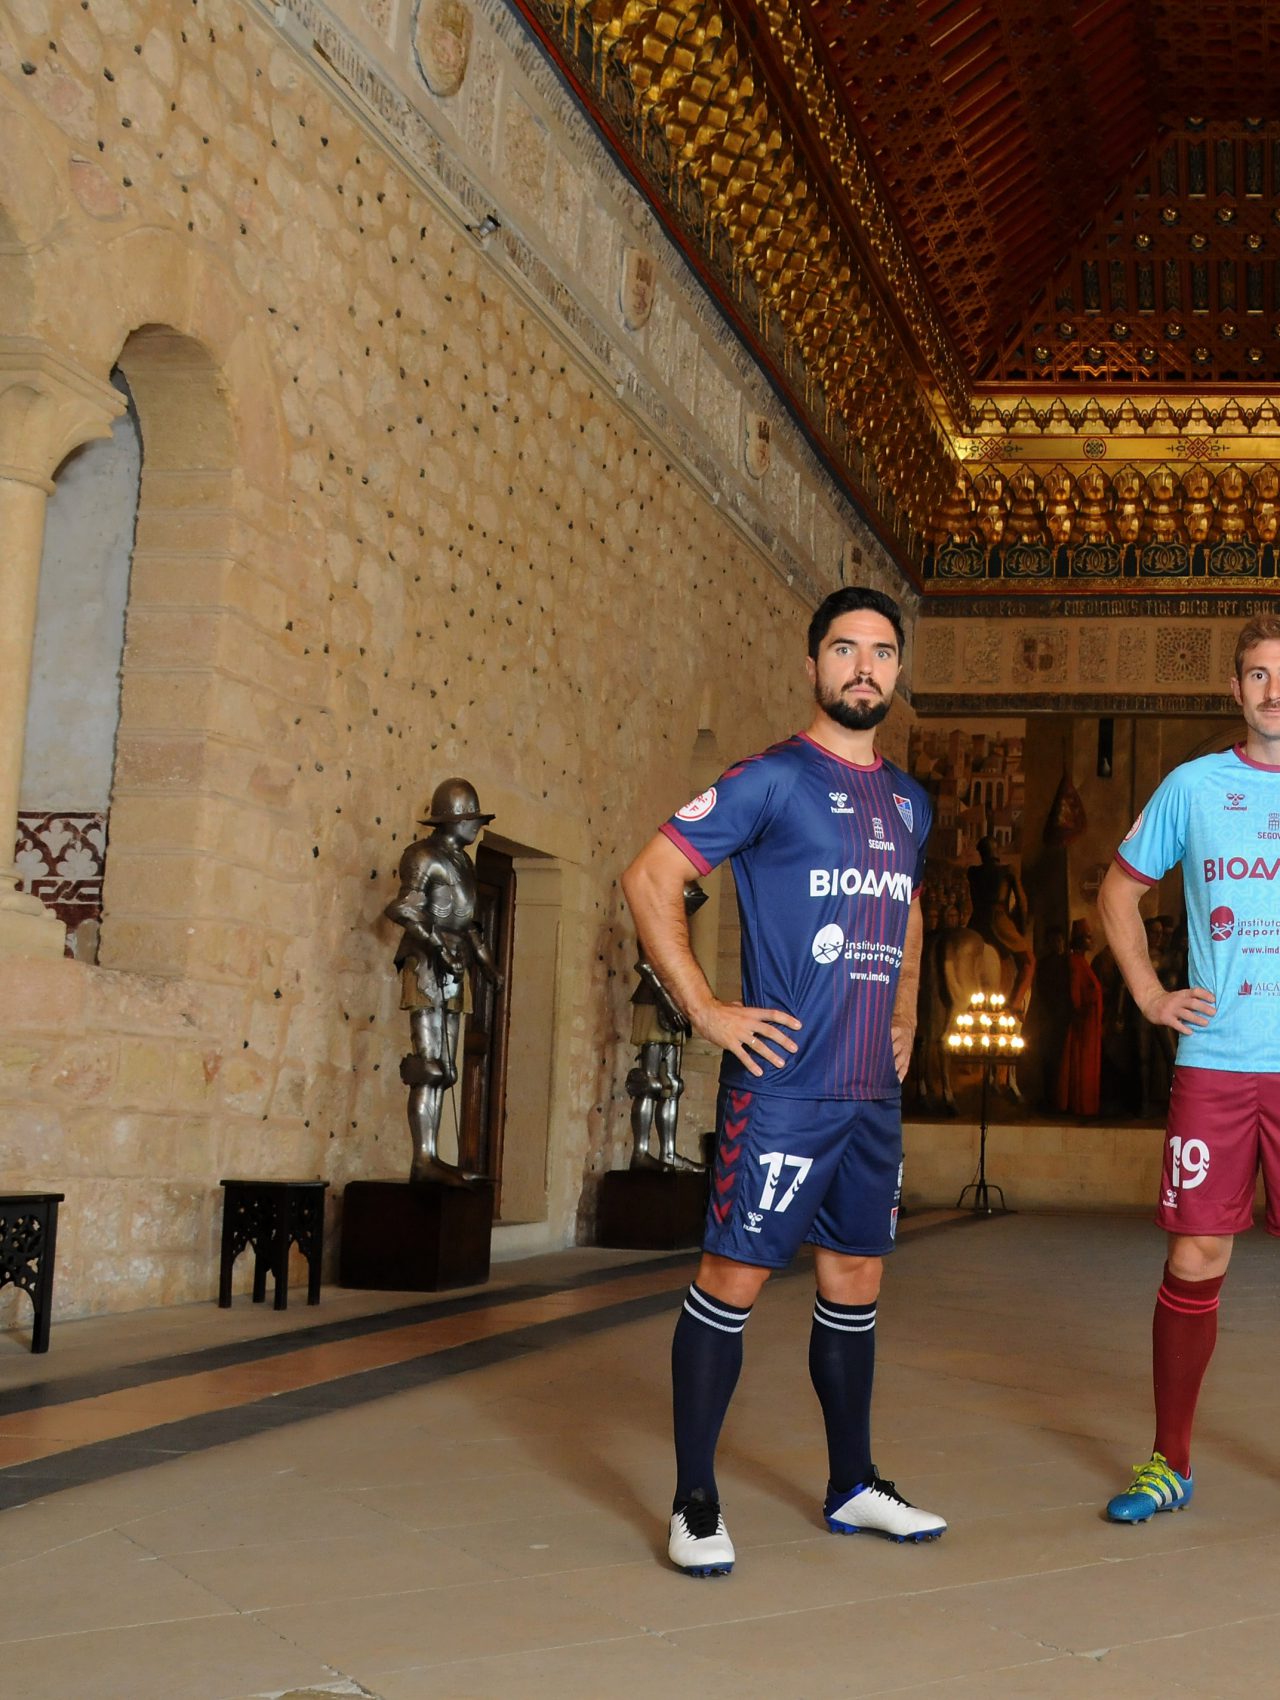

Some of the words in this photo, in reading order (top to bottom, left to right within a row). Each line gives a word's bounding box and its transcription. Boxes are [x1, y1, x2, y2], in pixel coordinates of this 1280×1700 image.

[868, 839, 896, 851] SEGOVIA
[759, 1151, 814, 1213] 17
[1169, 1135, 1210, 1190] 19
